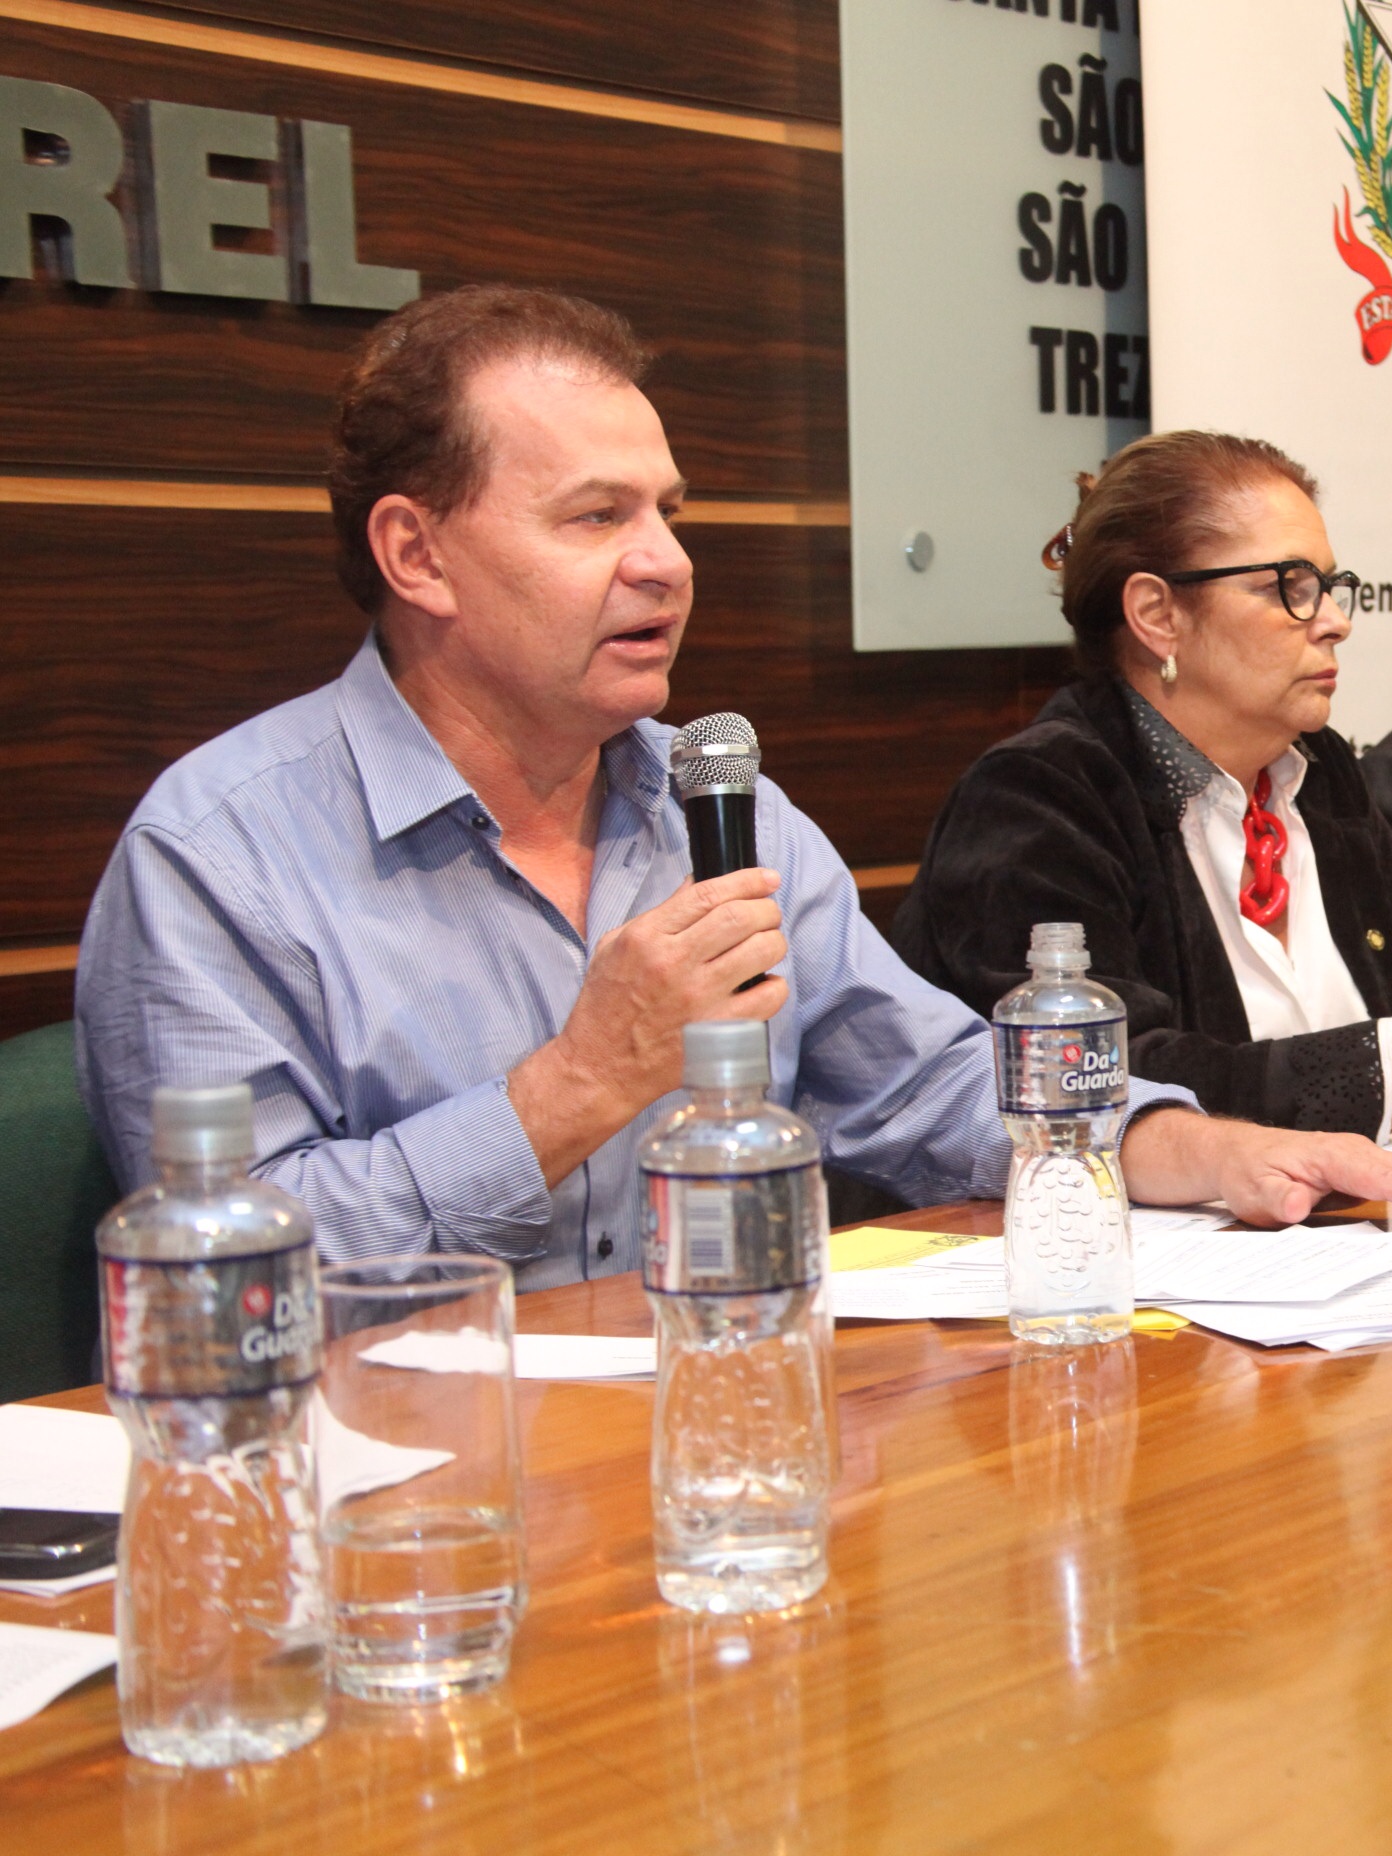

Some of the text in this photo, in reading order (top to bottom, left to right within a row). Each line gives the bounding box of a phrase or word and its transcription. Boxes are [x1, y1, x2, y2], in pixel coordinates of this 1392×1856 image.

[1038, 52, 1144, 167] SÃO
[0, 76, 420, 312] REL
[1017, 180, 1128, 292] SÃO
[1061, 1065, 1125, 1092] Guarda
[1083, 1051, 1110, 1072] Da
